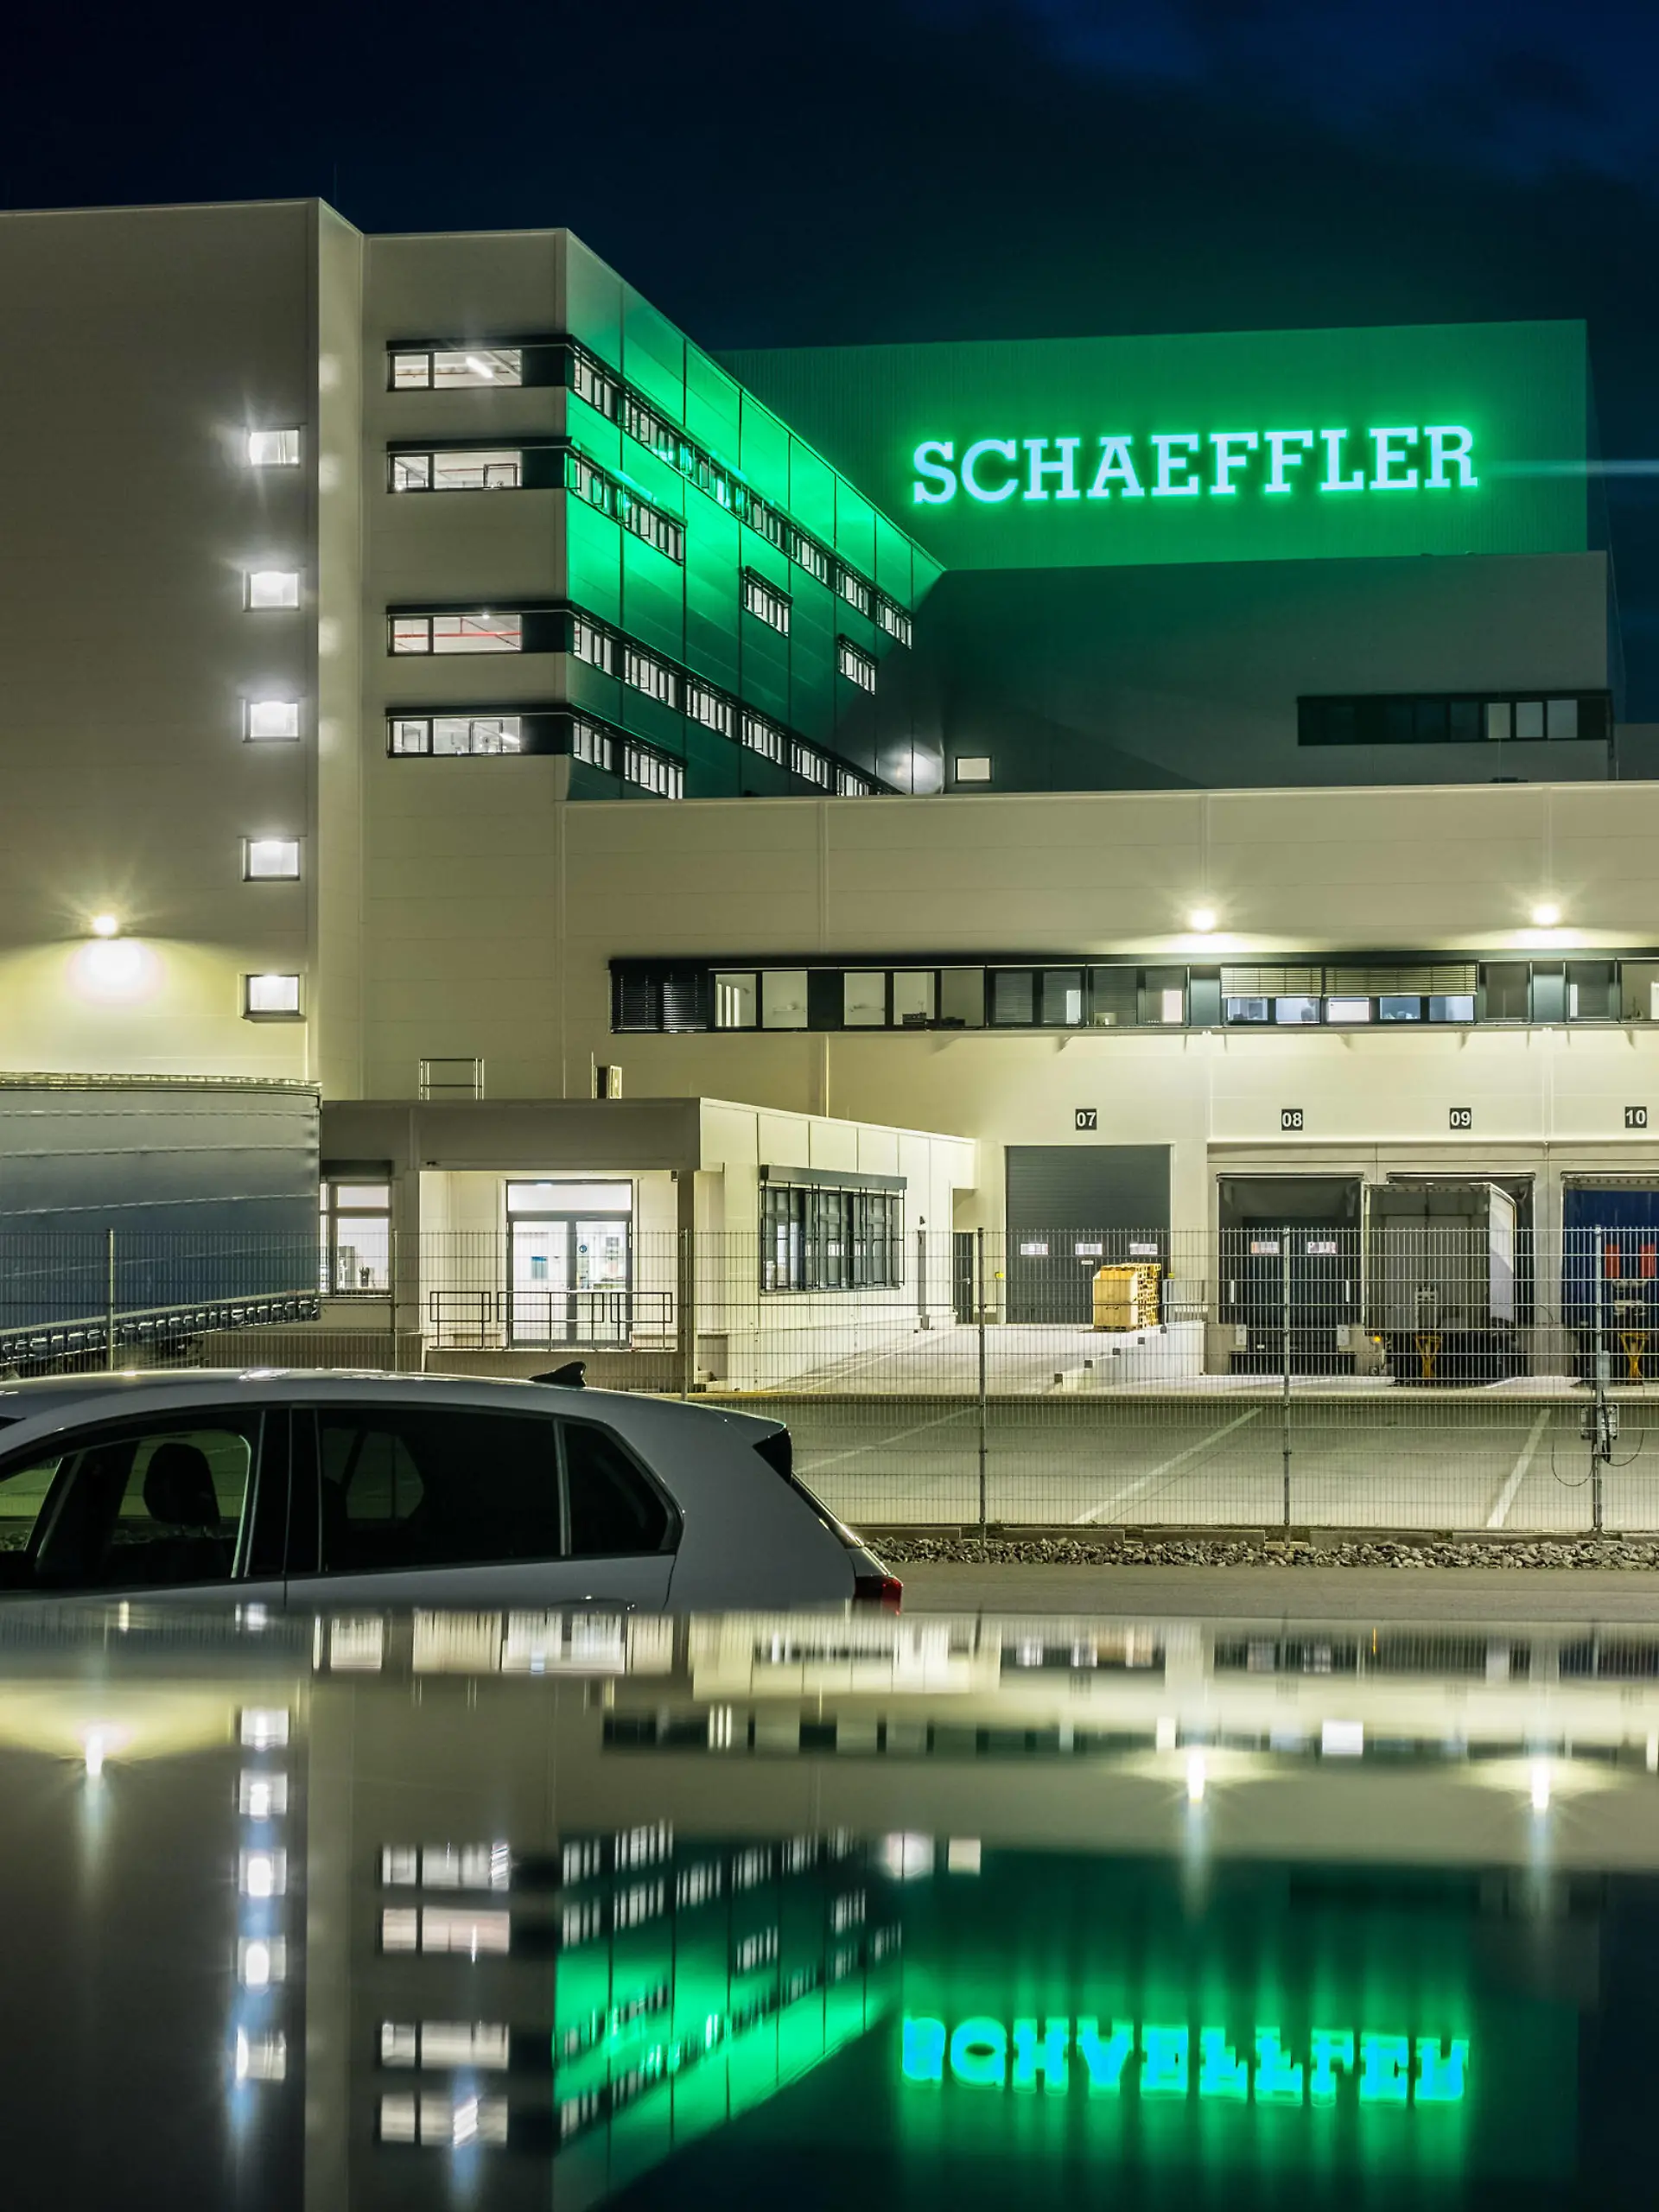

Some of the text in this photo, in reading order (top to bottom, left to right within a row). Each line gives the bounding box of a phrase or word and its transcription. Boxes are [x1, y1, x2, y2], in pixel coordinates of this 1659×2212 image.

[912, 425, 1478, 504] SCHAEFFLER
[1077, 1112, 1096, 1127] 07
[1282, 1112, 1302, 1127] 08
[1450, 1111, 1471, 1126] 09
[1625, 1109, 1646, 1125] 10
